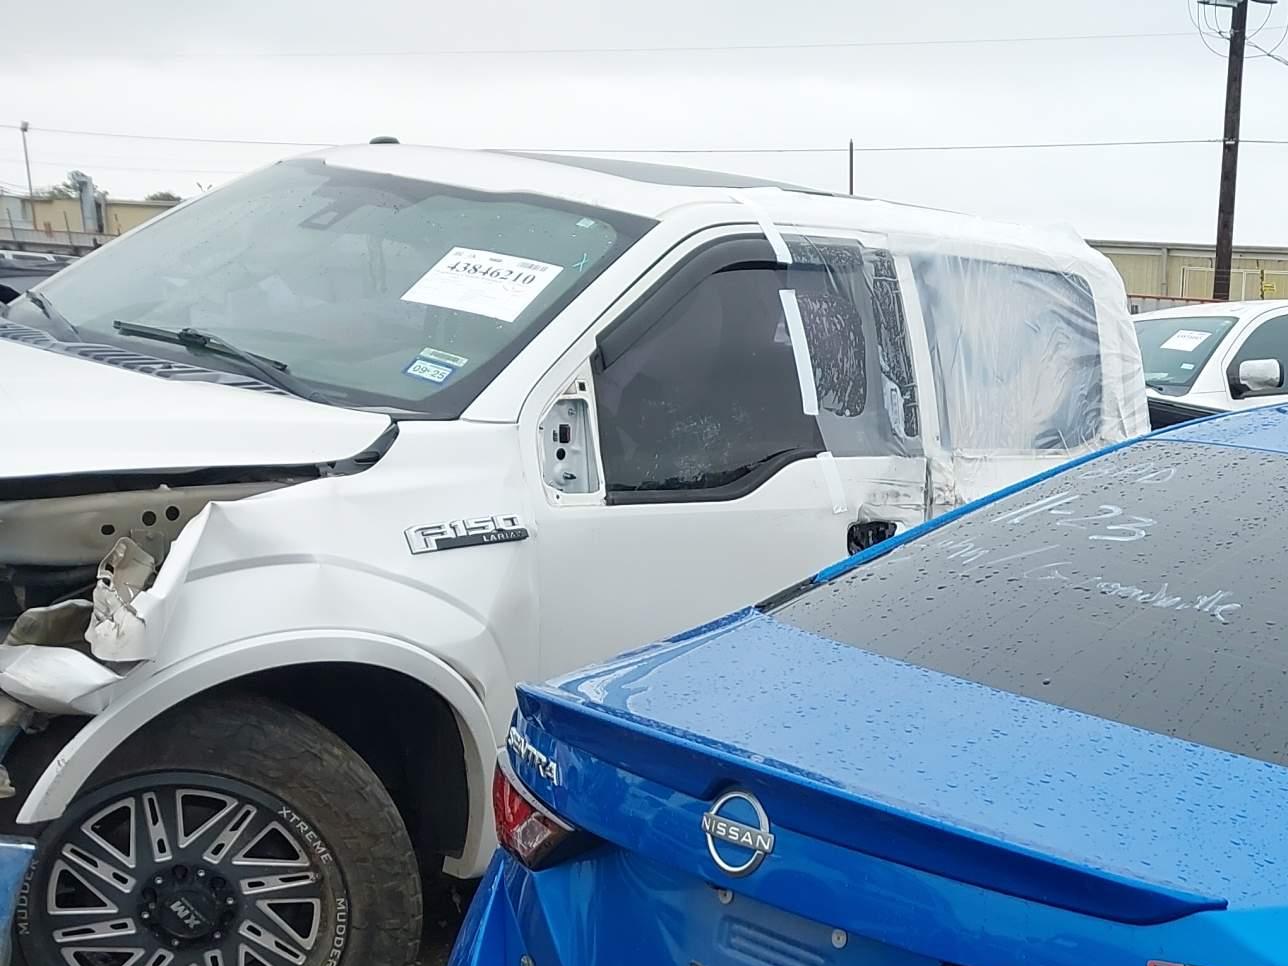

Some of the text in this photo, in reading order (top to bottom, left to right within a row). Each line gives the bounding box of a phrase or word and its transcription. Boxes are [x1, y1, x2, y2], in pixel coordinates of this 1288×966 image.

[448, 260, 536, 285] 43846210
[278, 806, 333, 865] XTREME
[701, 815, 771, 850] NISSAN
